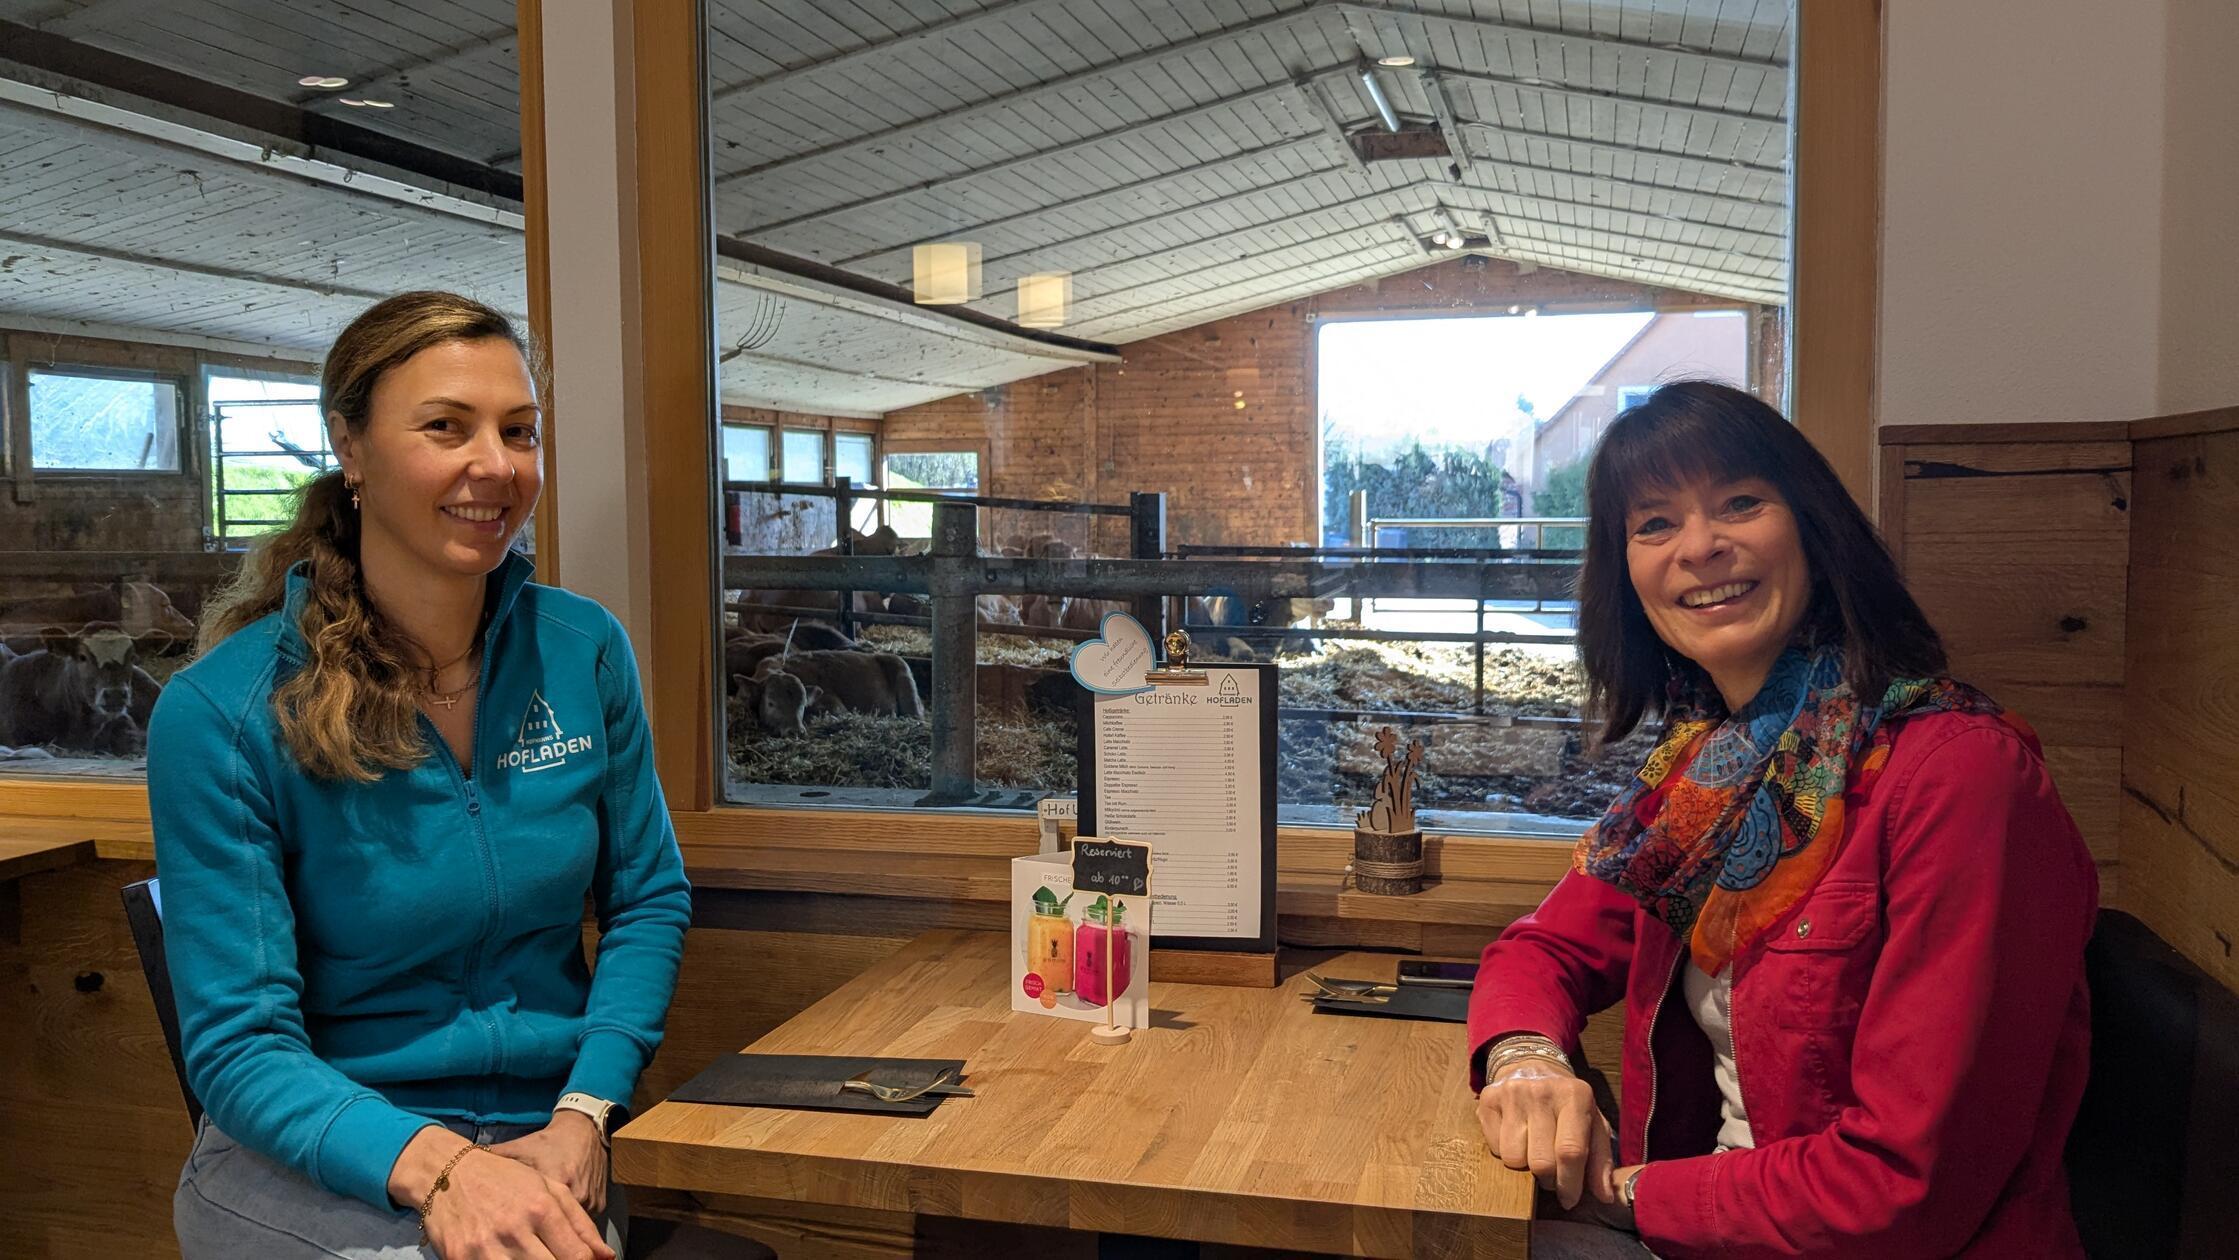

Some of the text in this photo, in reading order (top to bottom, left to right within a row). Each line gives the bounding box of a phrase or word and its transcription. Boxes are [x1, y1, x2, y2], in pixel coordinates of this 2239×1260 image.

[1135, 692, 1199, 706] Getränke
[1206, 696, 1253, 704] HOFLADEN
[497, 735, 592, 769] HOFLADEN
[1081, 843, 1133, 859] Reserviert
[1090, 872, 1105, 883] ab
